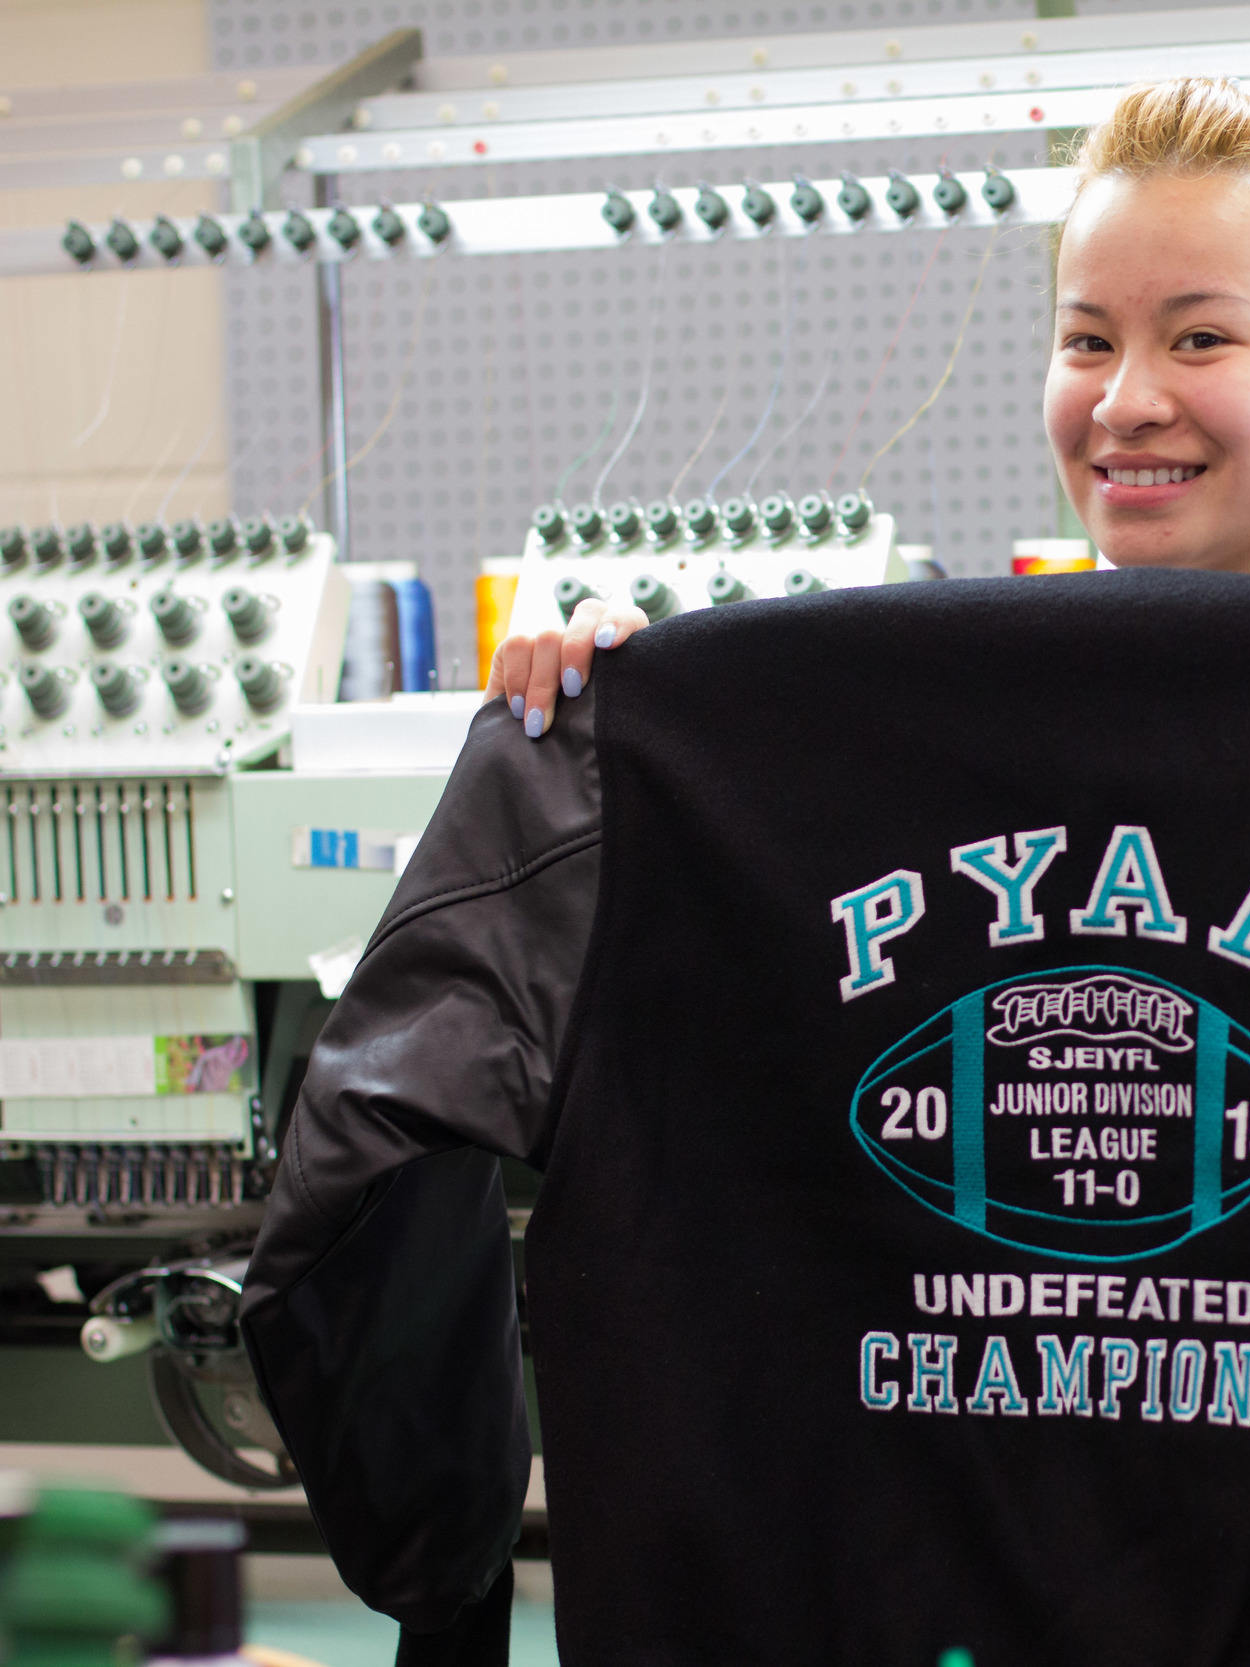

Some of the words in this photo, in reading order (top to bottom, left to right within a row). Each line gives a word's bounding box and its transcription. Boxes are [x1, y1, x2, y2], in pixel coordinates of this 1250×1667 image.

[1028, 1046, 1160, 1071] SJEIYFL
[881, 1086, 948, 1140] 20
[990, 1082, 1088, 1116] JUNIOR
[1094, 1083, 1193, 1117] DIVISION
[1030, 1127, 1158, 1161] LEAGUE
[1053, 1168, 1141, 1207] 11-0
